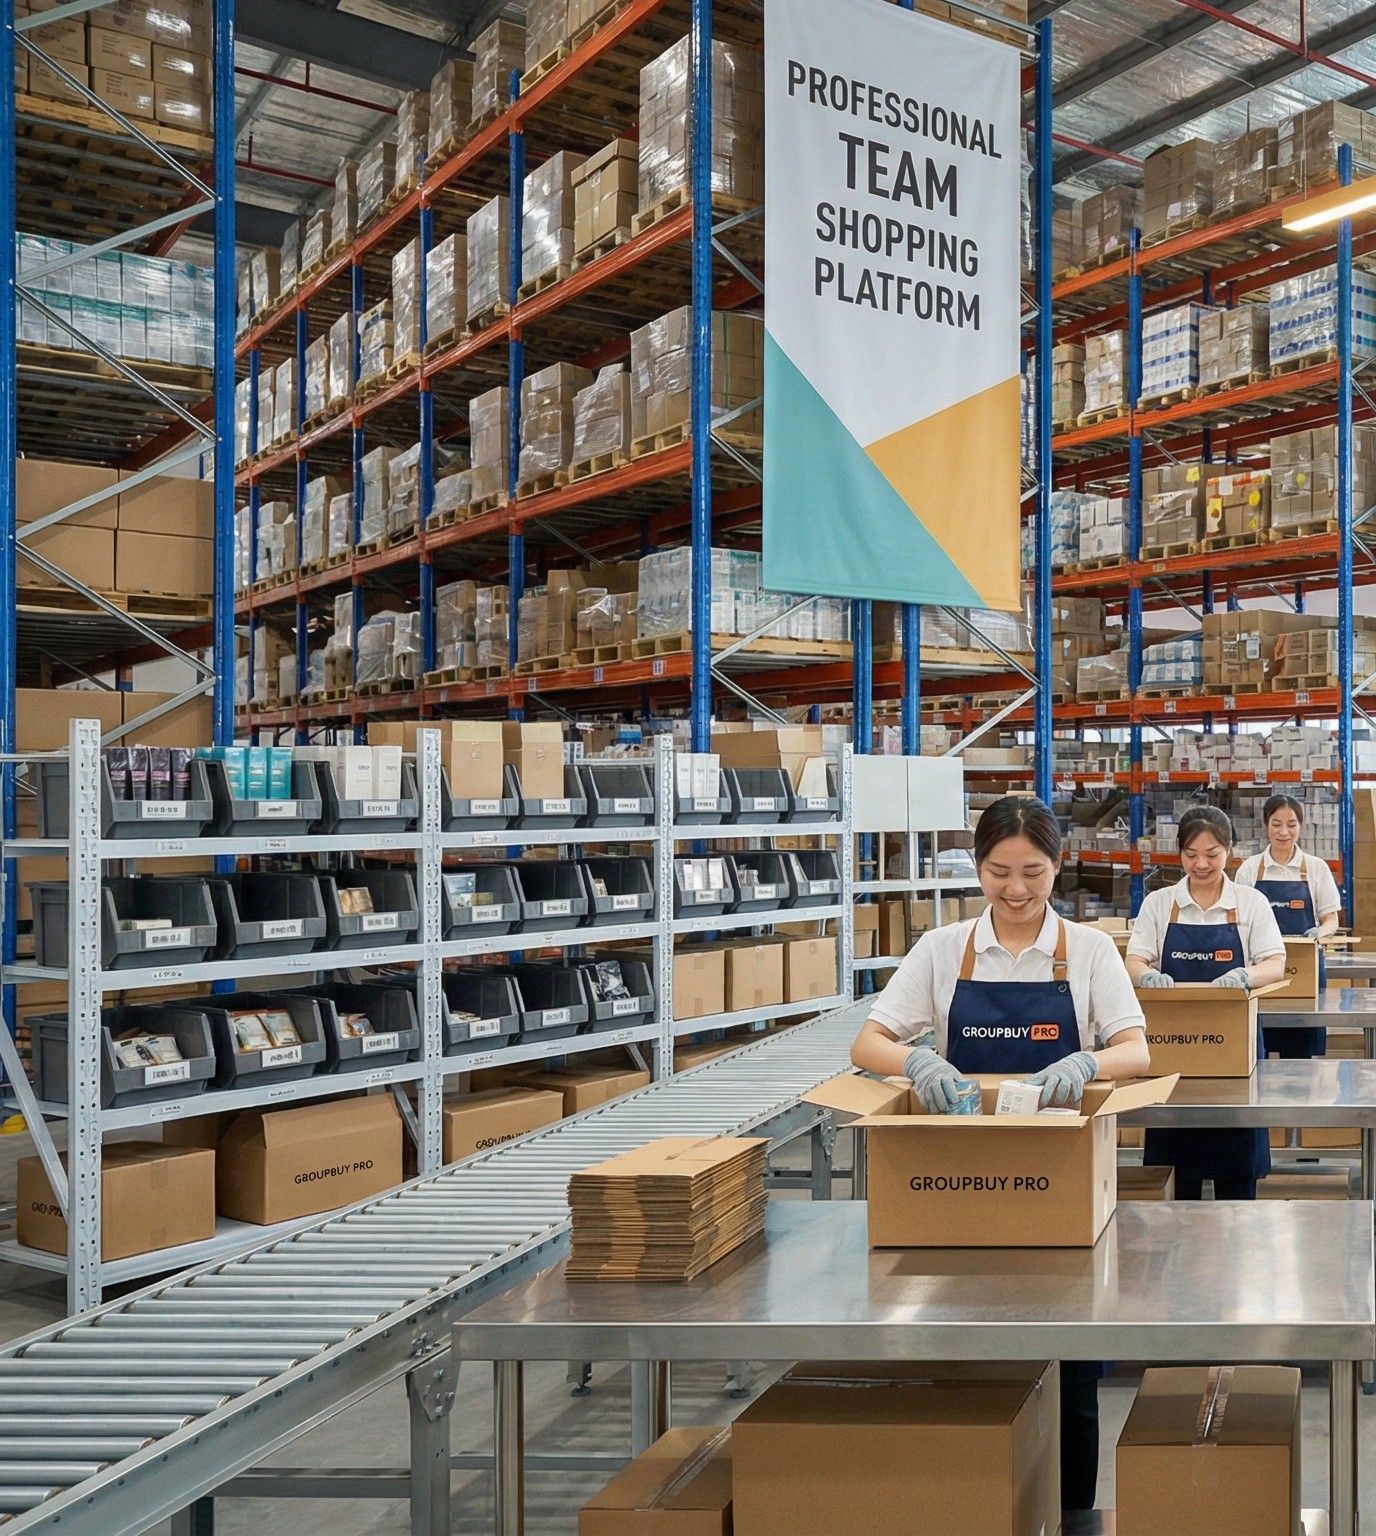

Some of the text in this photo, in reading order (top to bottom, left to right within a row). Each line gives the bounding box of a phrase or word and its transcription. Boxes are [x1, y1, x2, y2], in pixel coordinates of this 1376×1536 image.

[787, 59, 1002, 160] PROFESSIONAL
[838, 131, 958, 218] TEAM
[815, 201, 979, 278] SHOPPING
[814, 256, 981, 331] PLATFORM
[962, 1026, 1058, 1039] GROUPBUY PRO
[1202, 1034, 1225, 1045] PRO
[294, 1160, 374, 1184] GROUPBUY PRO
[909, 1176, 1050, 1191] GROUPBUY PRO
